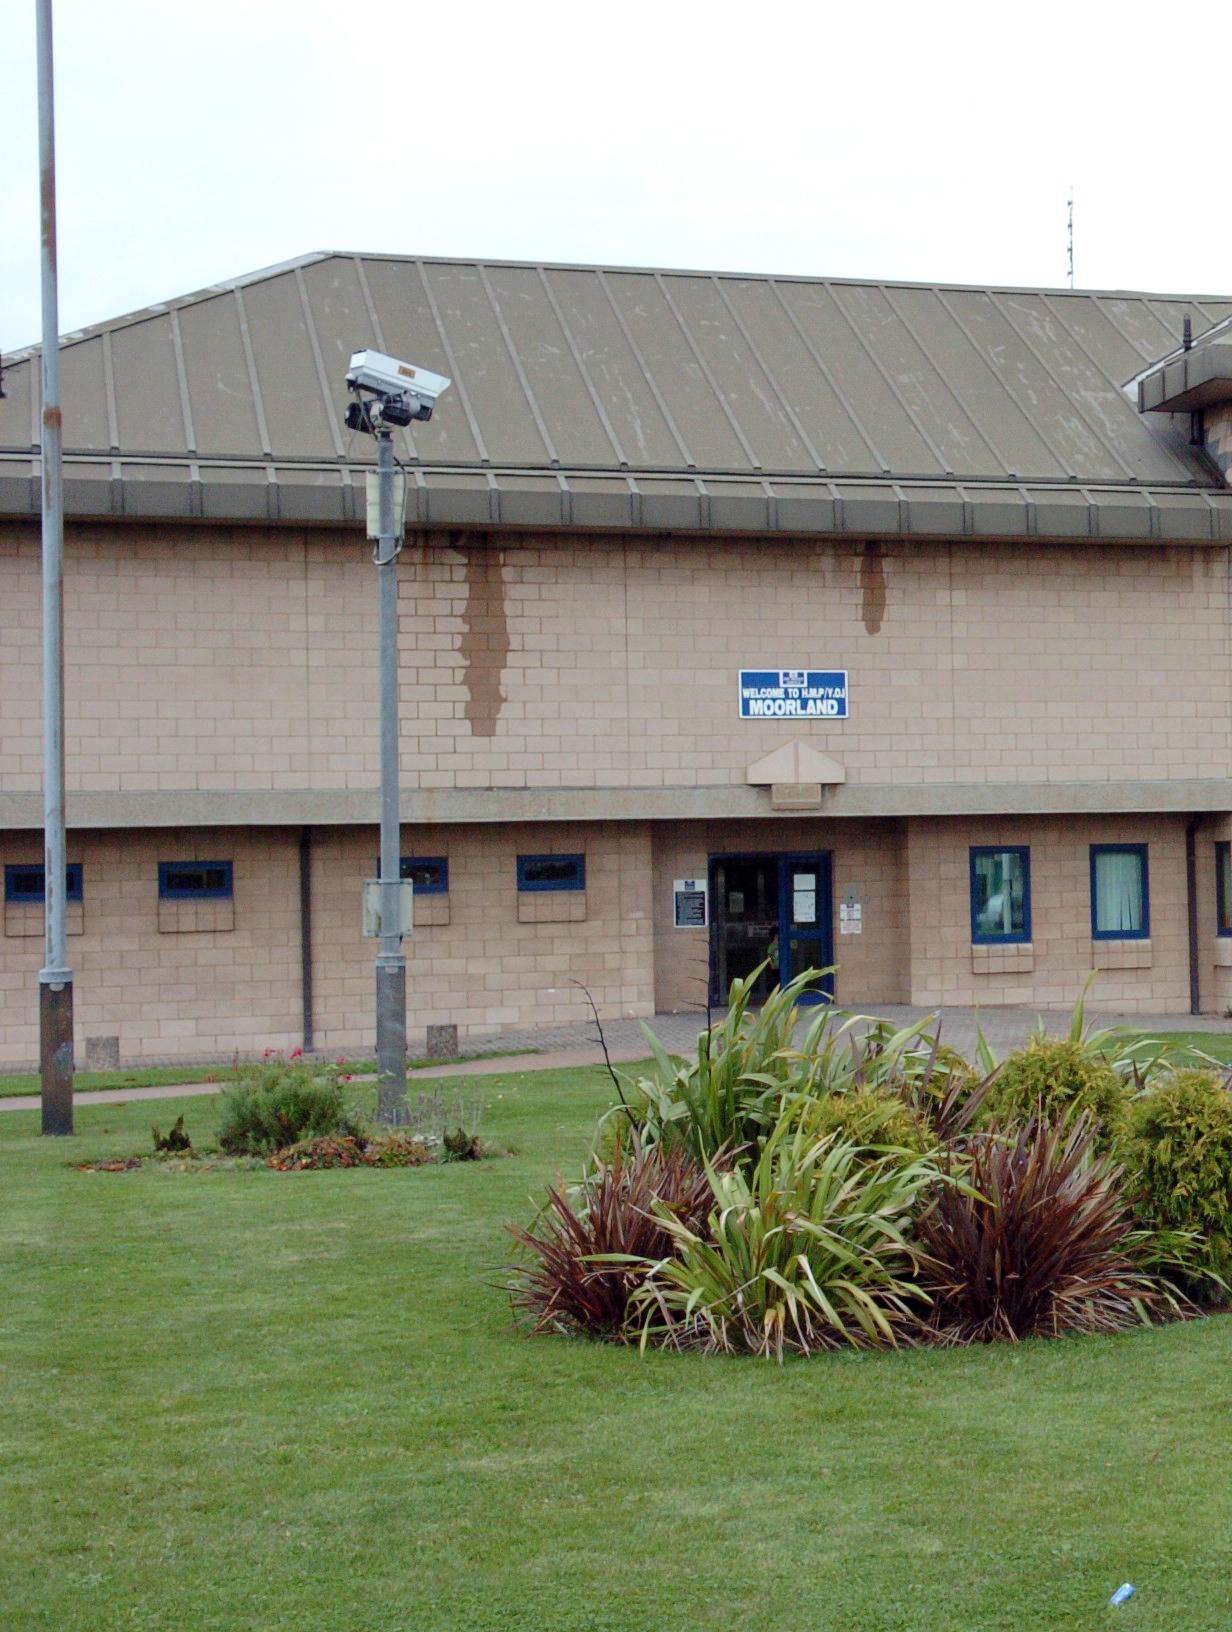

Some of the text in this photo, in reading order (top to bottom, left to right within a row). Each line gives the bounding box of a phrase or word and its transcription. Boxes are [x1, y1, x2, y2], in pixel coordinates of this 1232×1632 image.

[743, 688, 785, 698] WELCOME
[788, 688, 800, 698] TO
[749, 699, 839, 715] MOORLAND
